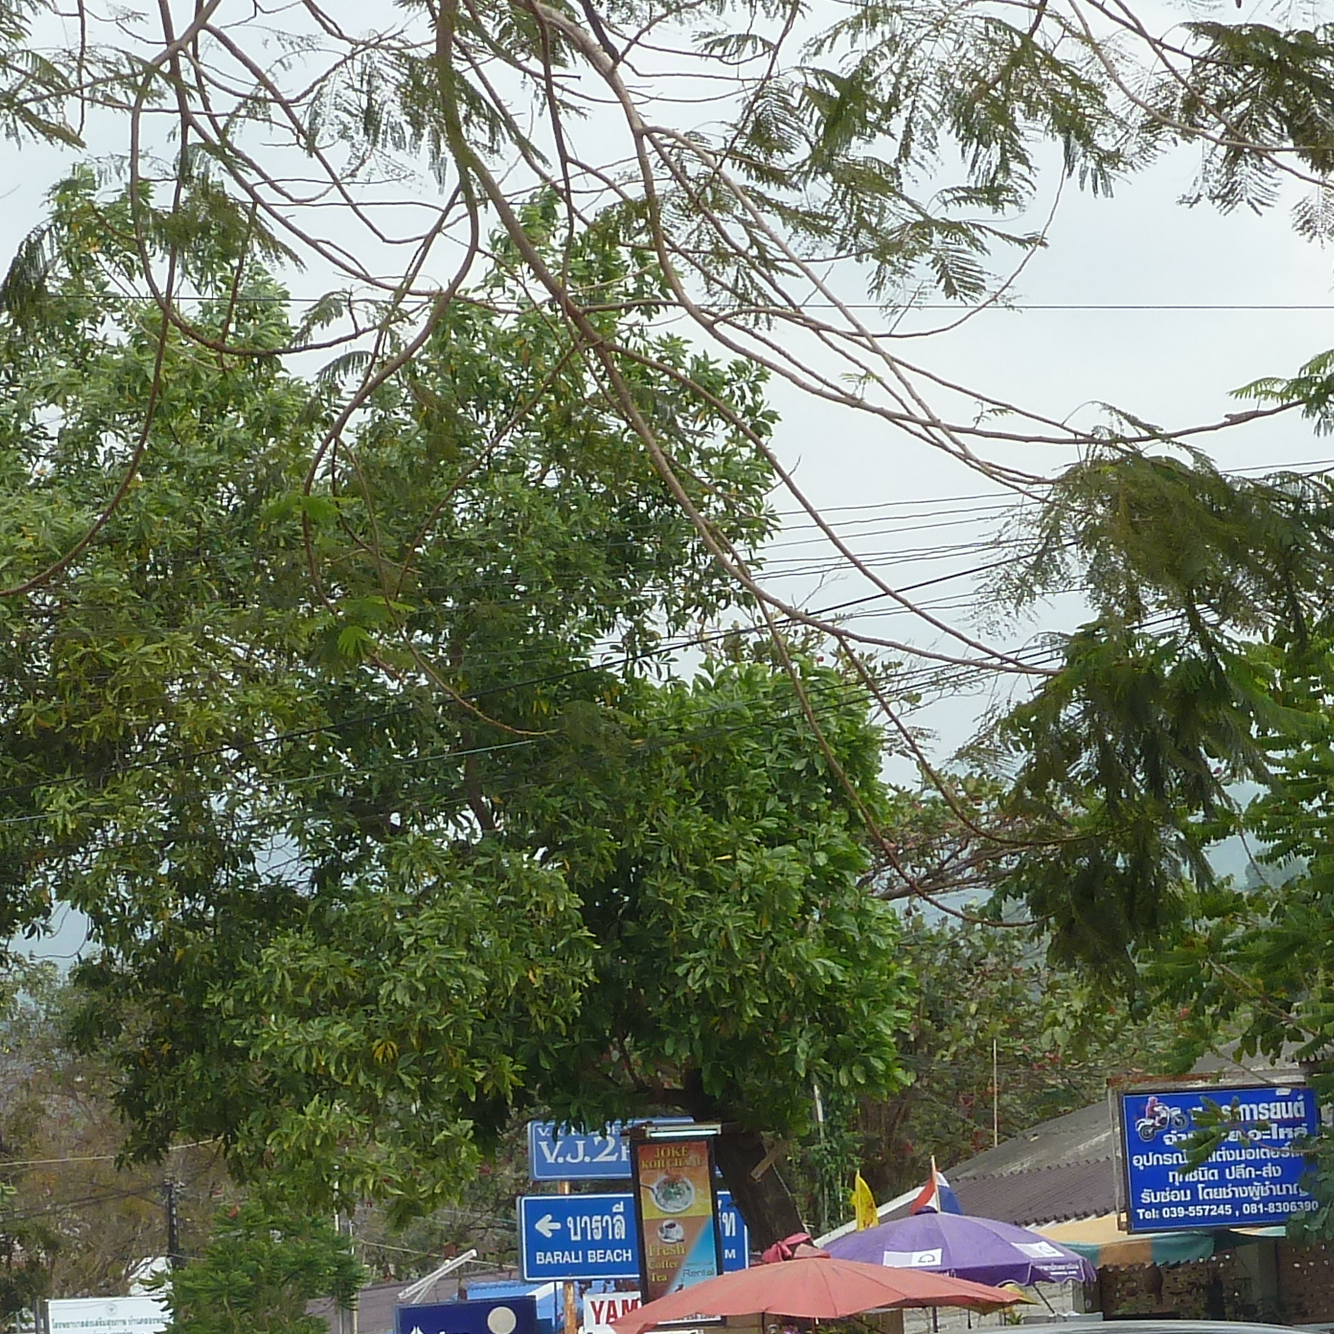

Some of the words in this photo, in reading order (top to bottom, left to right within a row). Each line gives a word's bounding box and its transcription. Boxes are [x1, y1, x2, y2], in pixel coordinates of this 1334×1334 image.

[654, 1146, 689, 1158] JOKE
[1162, 1205, 1233, 1218] 039-557245
[1242, 1200, 1319, 1214] 081-8306390
[567, 1201, 627, 1242] บาราลี
[536, 1249, 583, 1264] BARALI
[587, 1248, 632, 1263] BEACH
[648, 1243, 686, 1257] Fresh
[651, 1274, 668, 1283] Tea
